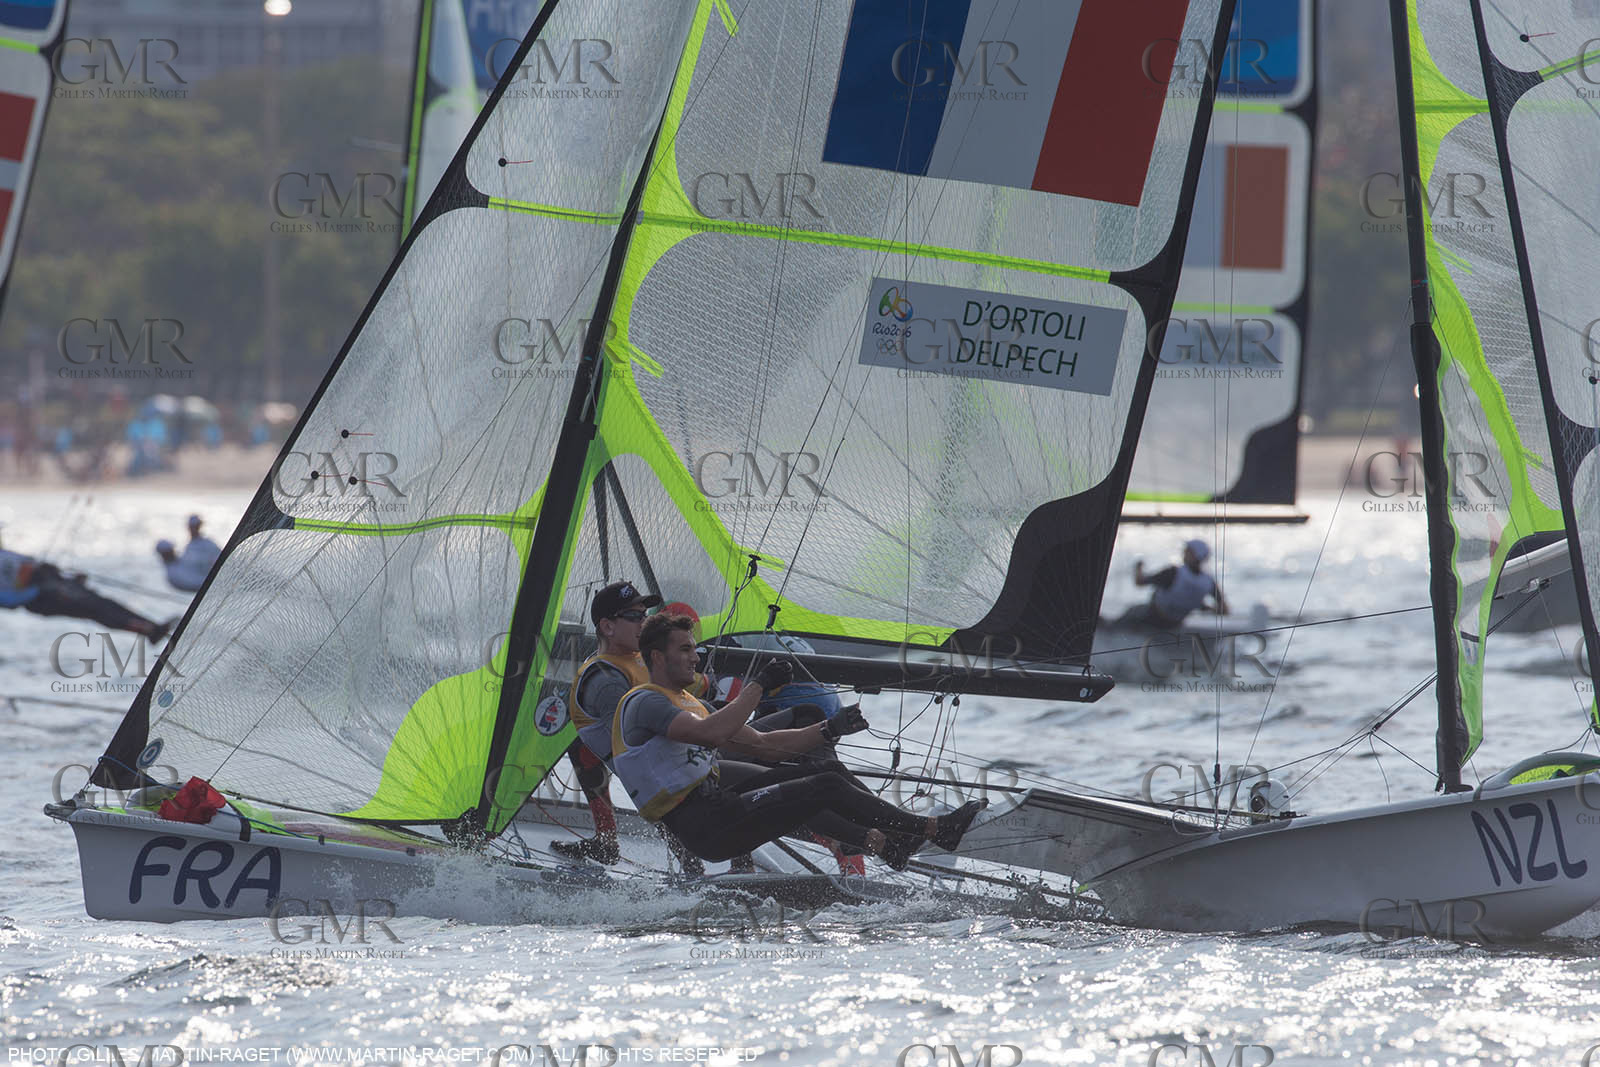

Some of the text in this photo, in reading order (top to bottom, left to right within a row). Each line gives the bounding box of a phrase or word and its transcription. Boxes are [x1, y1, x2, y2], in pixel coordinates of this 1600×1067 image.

[963, 301, 1086, 341] D'ORTOLI
[956, 337, 1078, 377] DELPECH
[1471, 798, 1588, 887] NZL
[129, 835, 282, 909] FRA
